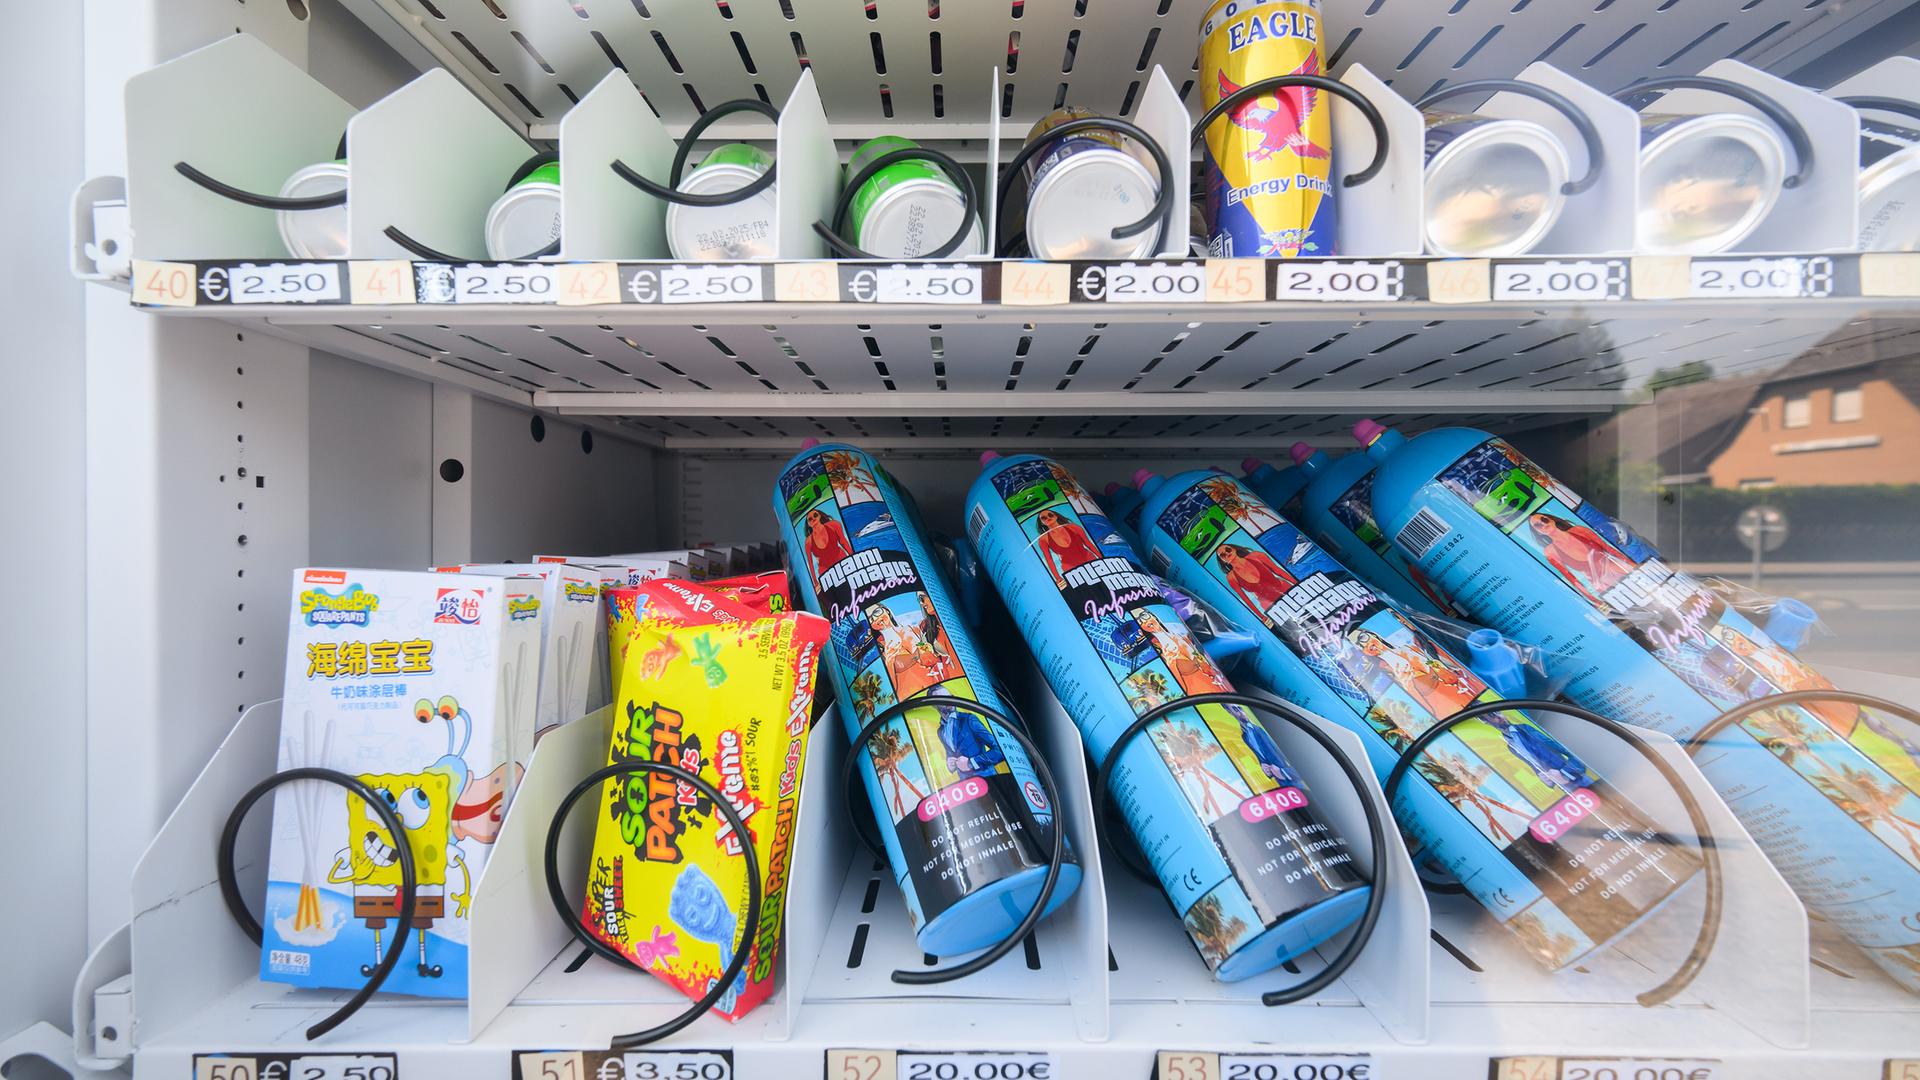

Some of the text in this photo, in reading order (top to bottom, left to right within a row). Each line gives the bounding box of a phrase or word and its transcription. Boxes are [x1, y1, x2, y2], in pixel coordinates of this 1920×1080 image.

[1229, 11, 1317, 51] EAGLE
[1227, 174, 1332, 206] Energy Drink
[146, 269, 188, 299] 40
[199, 268, 327, 301] € 2.50
[366, 268, 404, 296] 41
[466, 274, 552, 295] 2.50
[568, 269, 610, 299] 42
[628, 270, 754, 303] € 2.50
[848, 269, 877, 302] €
[1012, 270, 1054, 298] 44
[1077, 266, 1199, 300] € 2.00
[1212, 268, 1253, 297] 45
[1288, 271, 1379, 297] 2,00
[1507, 272, 1598, 297] 2,00
[1700, 270, 1791, 292] 2,00
[1444, 533, 1465, 552] E942
[830, 574, 917, 627] Infusions
[1299, 593, 1377, 659] Infusions
[306, 638, 433, 679] 海绵宝宝
[776, 649, 787, 662] 3.5
[778, 638, 789, 650] OZ
[772, 679, 783, 691] NET
[774, 663, 784, 678] WT
[745, 717, 762, 746] SOUR
[621, 706, 655, 848] SOUR
[646, 707, 684, 861] PATCH
[780, 738, 802, 798] Kids
[925, 781, 980, 816] 640G
[1249, 790, 1302, 818] 640G
[1540, 793, 1594, 836] 640G
[932, 810, 1000, 848] DO NOT REFILL
[1265, 823, 1328, 850] DO NOT REFILL
[1568, 821, 1631, 868] DO NOT REFILL
[765, 798, 795, 897] PATCH
[923, 821, 1023, 873] NOT FOR MEDICAL USE
[941, 840, 1015, 881] DO NOT INHALE
[1257, 837, 1349, 877] NOT FOR MEDICAL USE
[1568, 826, 1658, 896] NOT FOR MEDICAL USE
[1285, 853, 1352, 884] DO NOT INHALE
[1600, 848, 1667, 900] DO NOT INHALE
[604, 887, 619, 936] SOUR
[613, 855, 629, 943] THEN SWEET
[754, 892, 782, 985] SOUR
[541, 1059, 576, 1080] 51
[843, 1056, 882, 1080] 52
[1168, 1056, 1208, 1080] 53
